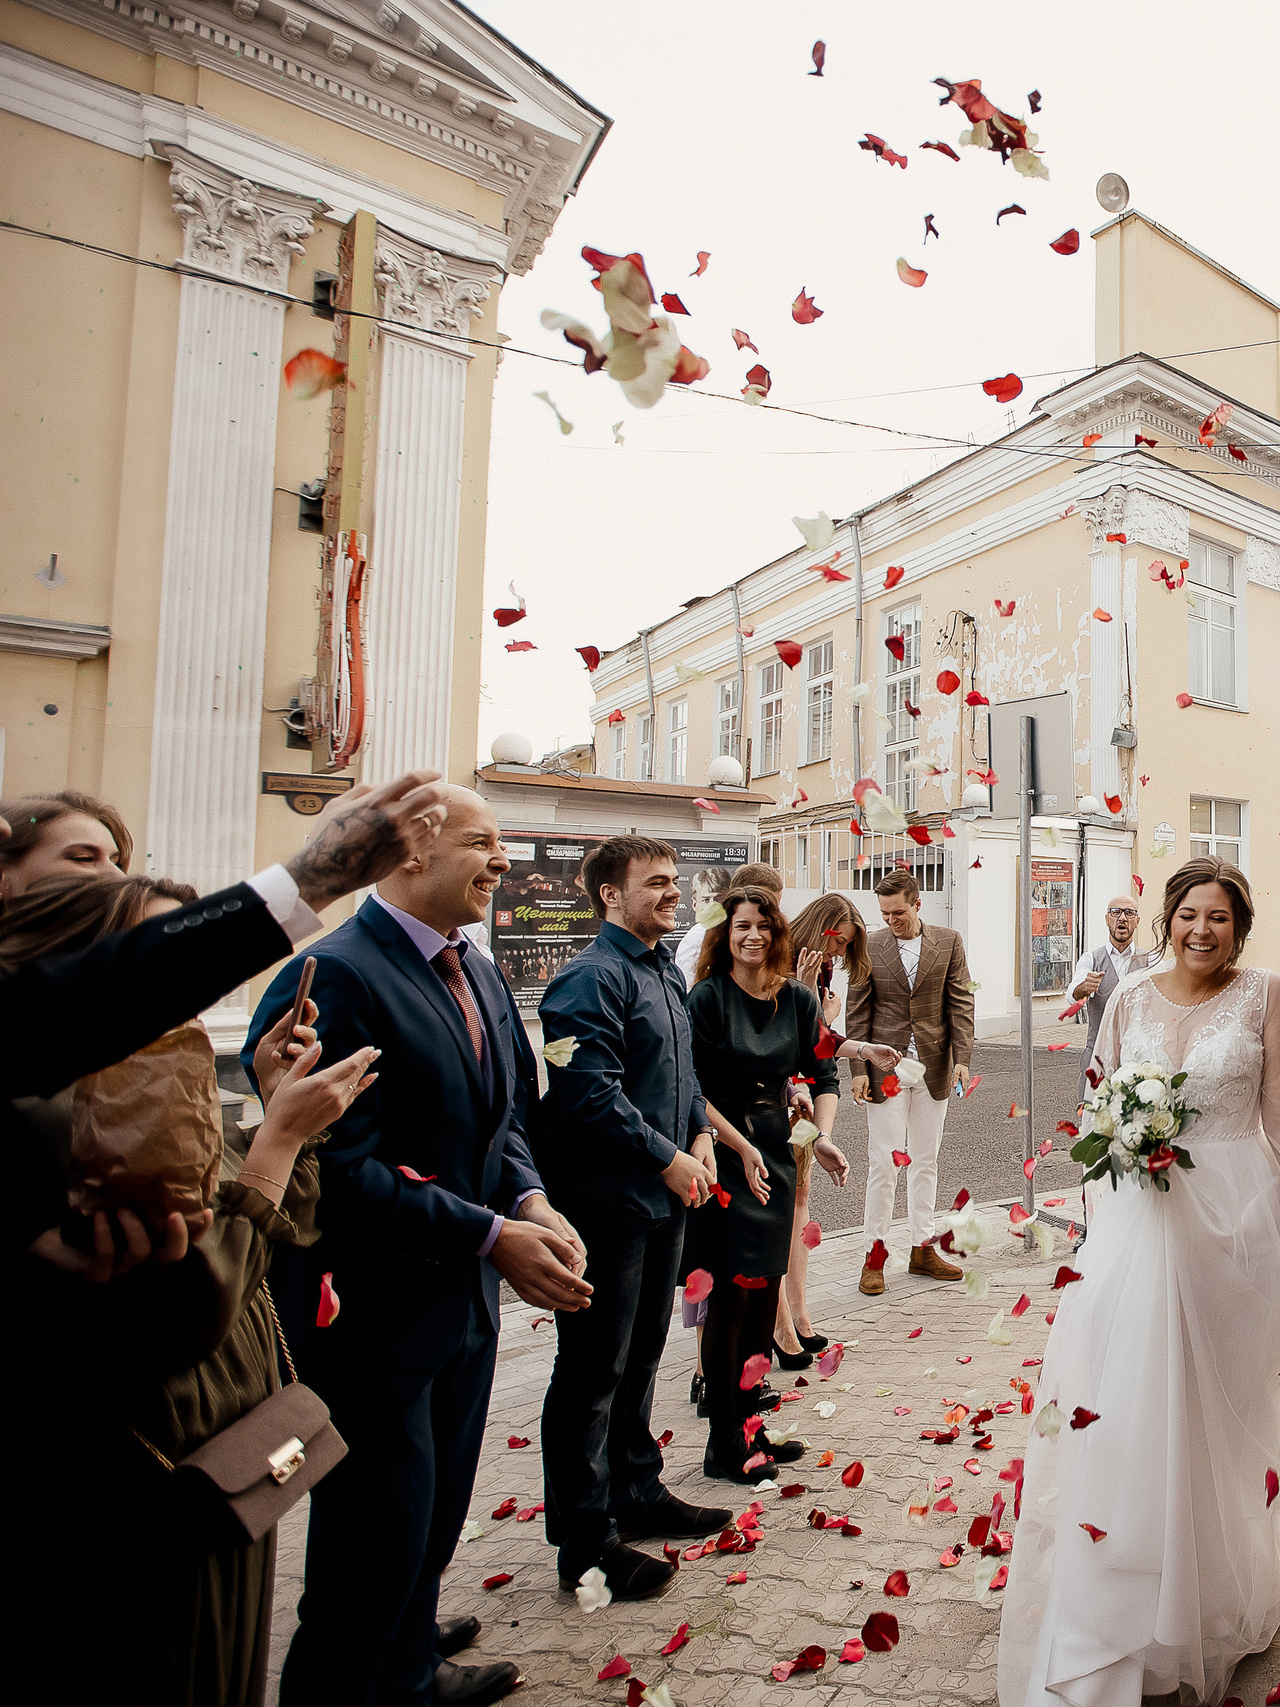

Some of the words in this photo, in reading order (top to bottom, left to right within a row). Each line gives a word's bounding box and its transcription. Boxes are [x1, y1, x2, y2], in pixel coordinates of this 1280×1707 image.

[300, 799, 316, 807] 13
[546, 849, 584, 857] ФИЛАРМОНИЯ
[724, 848, 746, 856] 18:30
[514, 905, 595, 922] Цветущий
[538, 920, 569, 932] май
